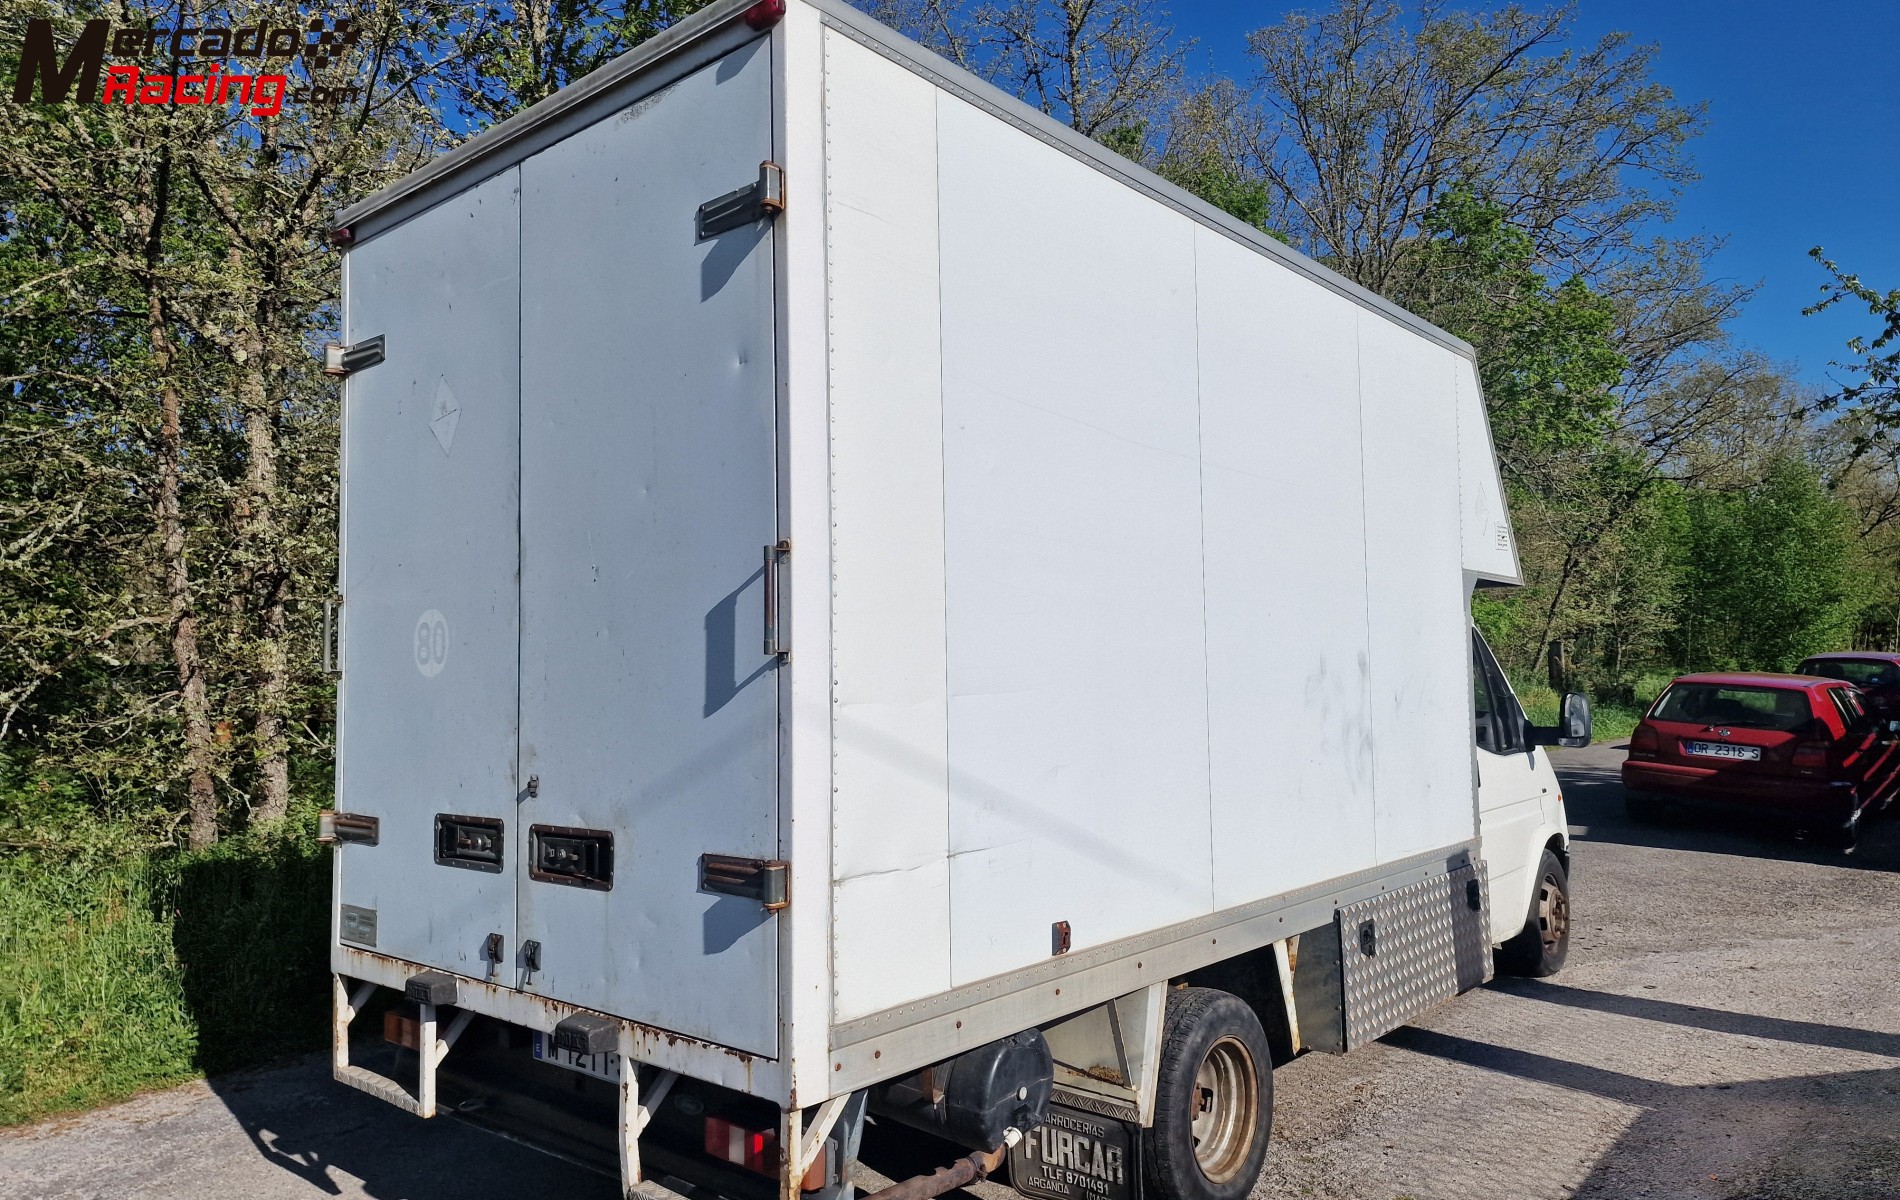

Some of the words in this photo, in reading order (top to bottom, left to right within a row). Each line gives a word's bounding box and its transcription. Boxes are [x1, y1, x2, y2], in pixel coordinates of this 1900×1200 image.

[417, 621, 446, 666] 80
[1694, 743, 1709, 754] OR
[1751, 749, 1759, 759] S
[1045, 1112, 1105, 1138] ARROCERIAS
[1024, 1125, 1124, 1185] FURCAR
[1028, 1176, 1070, 1195] ARGANDA
